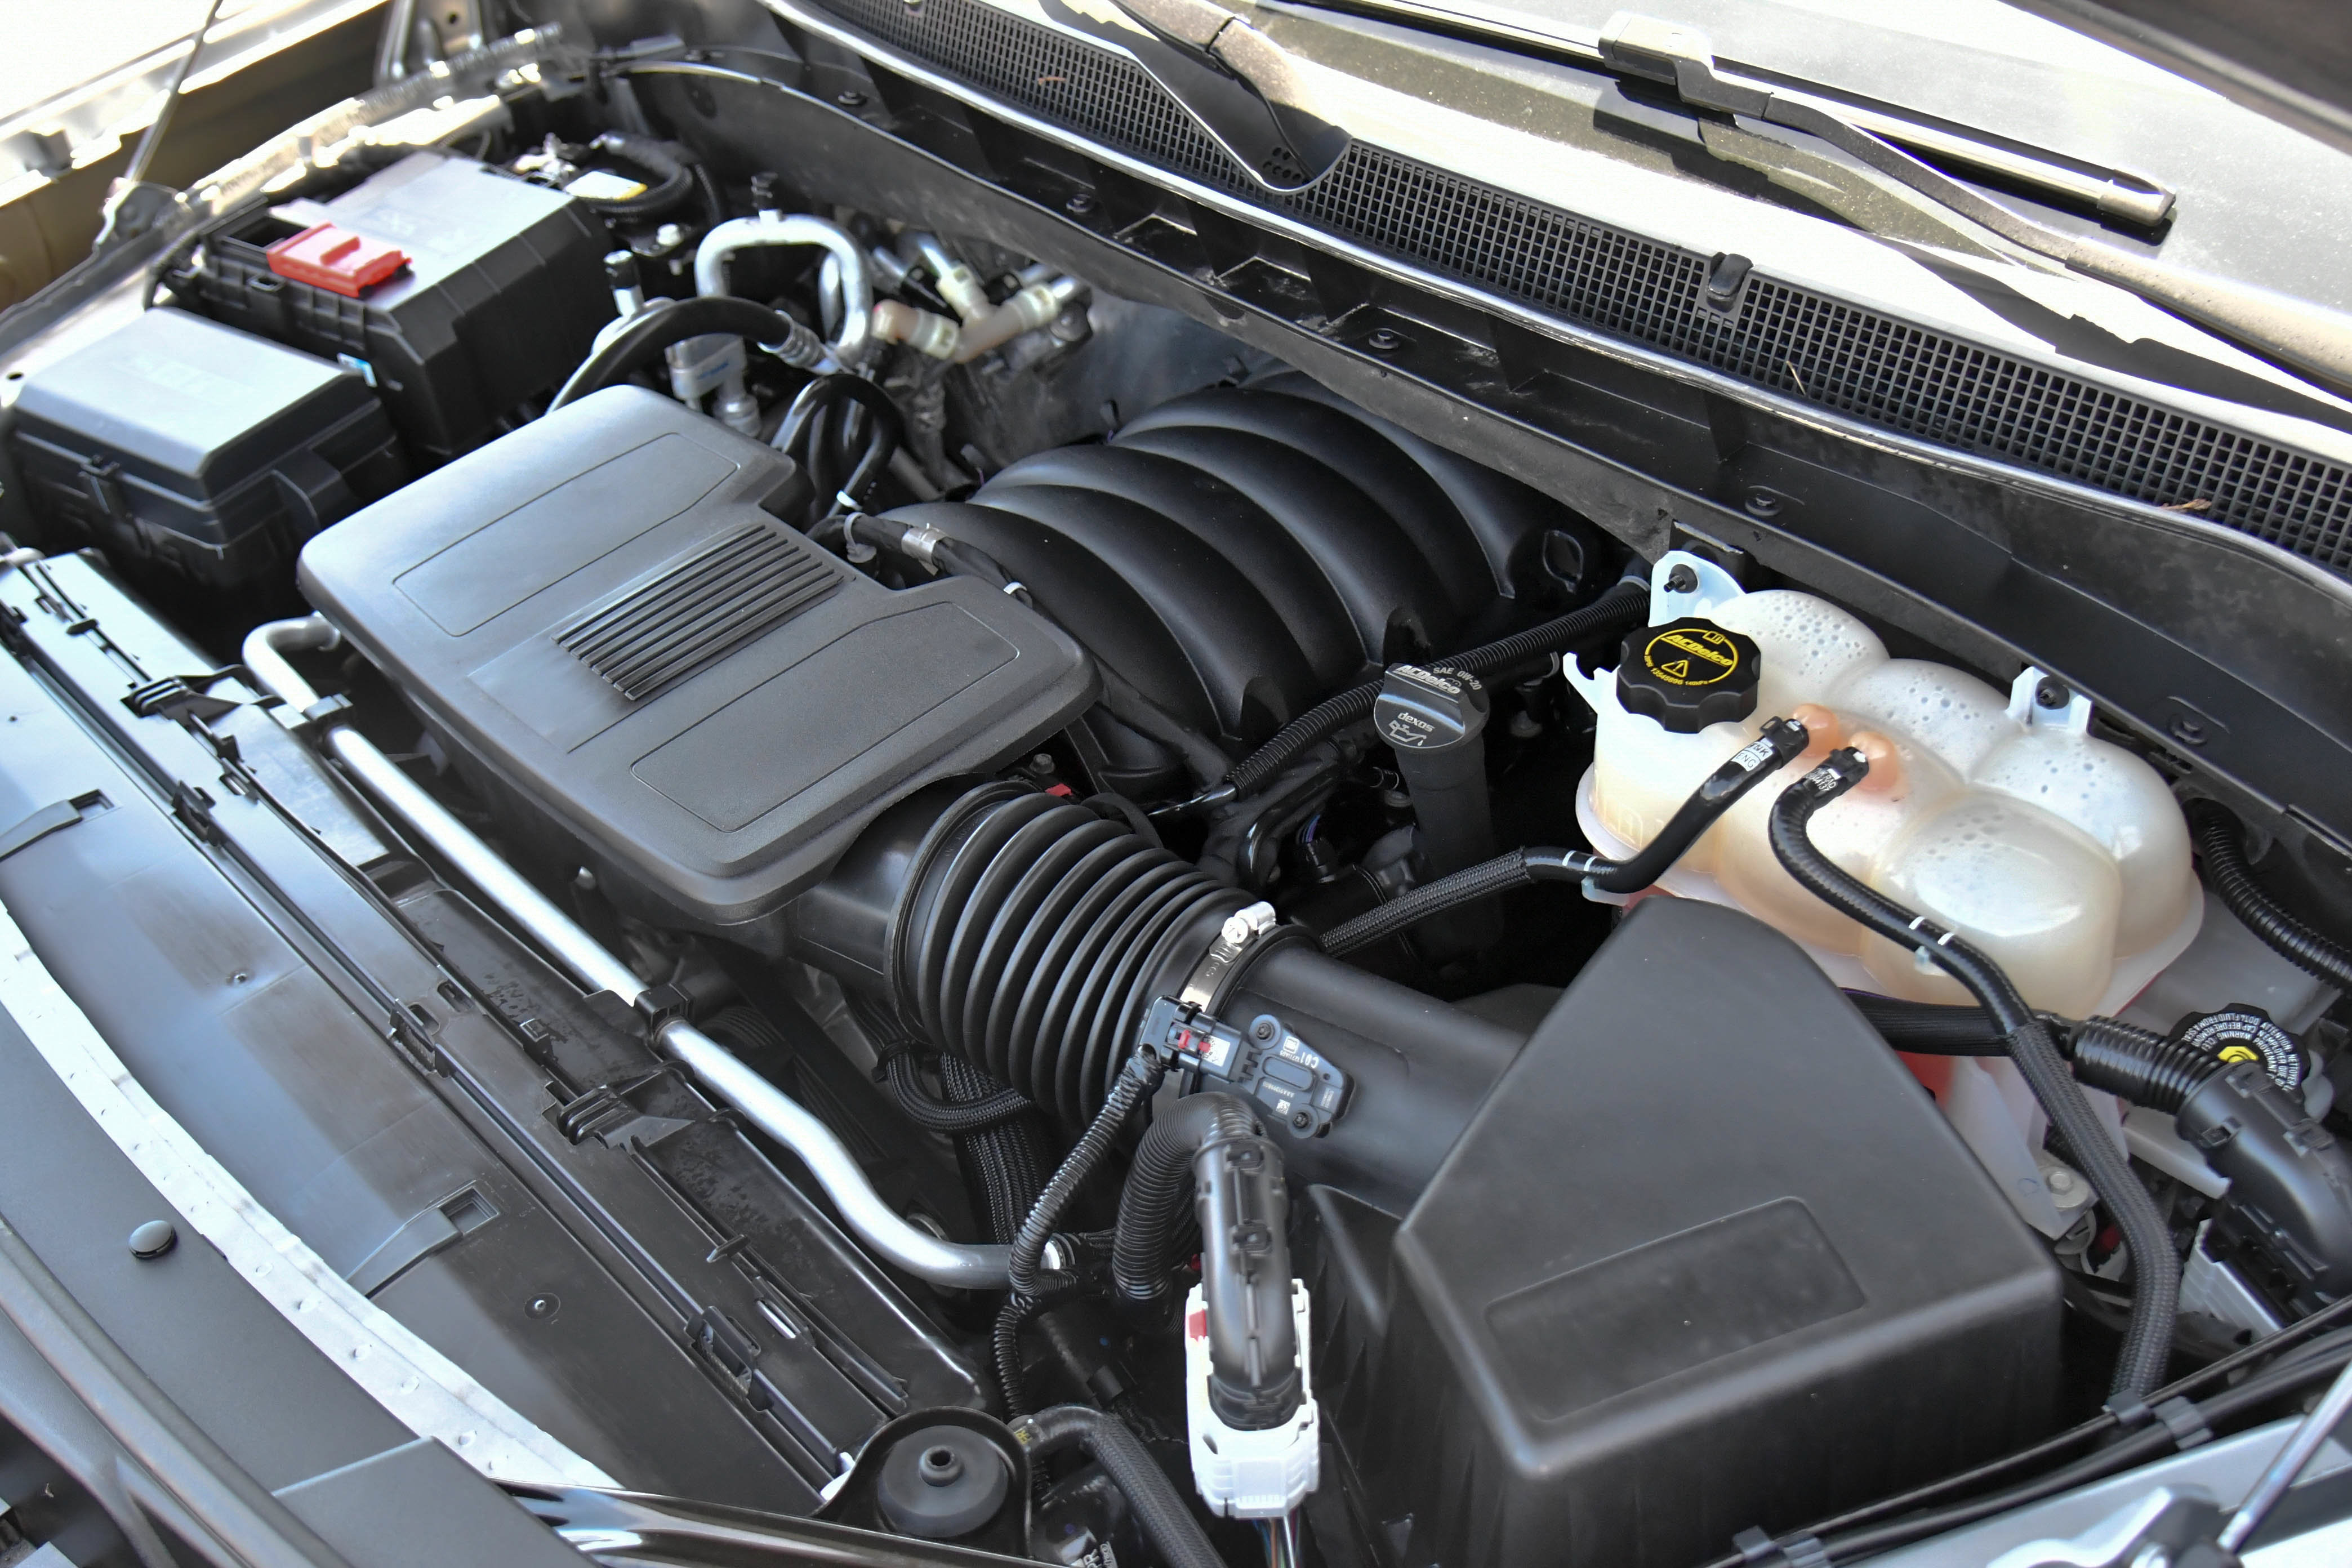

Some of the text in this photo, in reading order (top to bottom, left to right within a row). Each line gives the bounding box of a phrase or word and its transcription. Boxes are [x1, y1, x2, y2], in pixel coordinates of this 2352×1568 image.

[1665, 635, 1734, 666] ACDelco
[1396, 665, 1460, 694] ACDelco
[1457, 671, 1482, 690] 0W-20
[1397, 712, 1436, 732] dexos
[1736, 753, 1756, 768] ENG
[2197, 1016, 2218, 1027] FROM
[2219, 1013, 2239, 1021] FLUID
[2242, 1024, 2258, 1033] CAP
